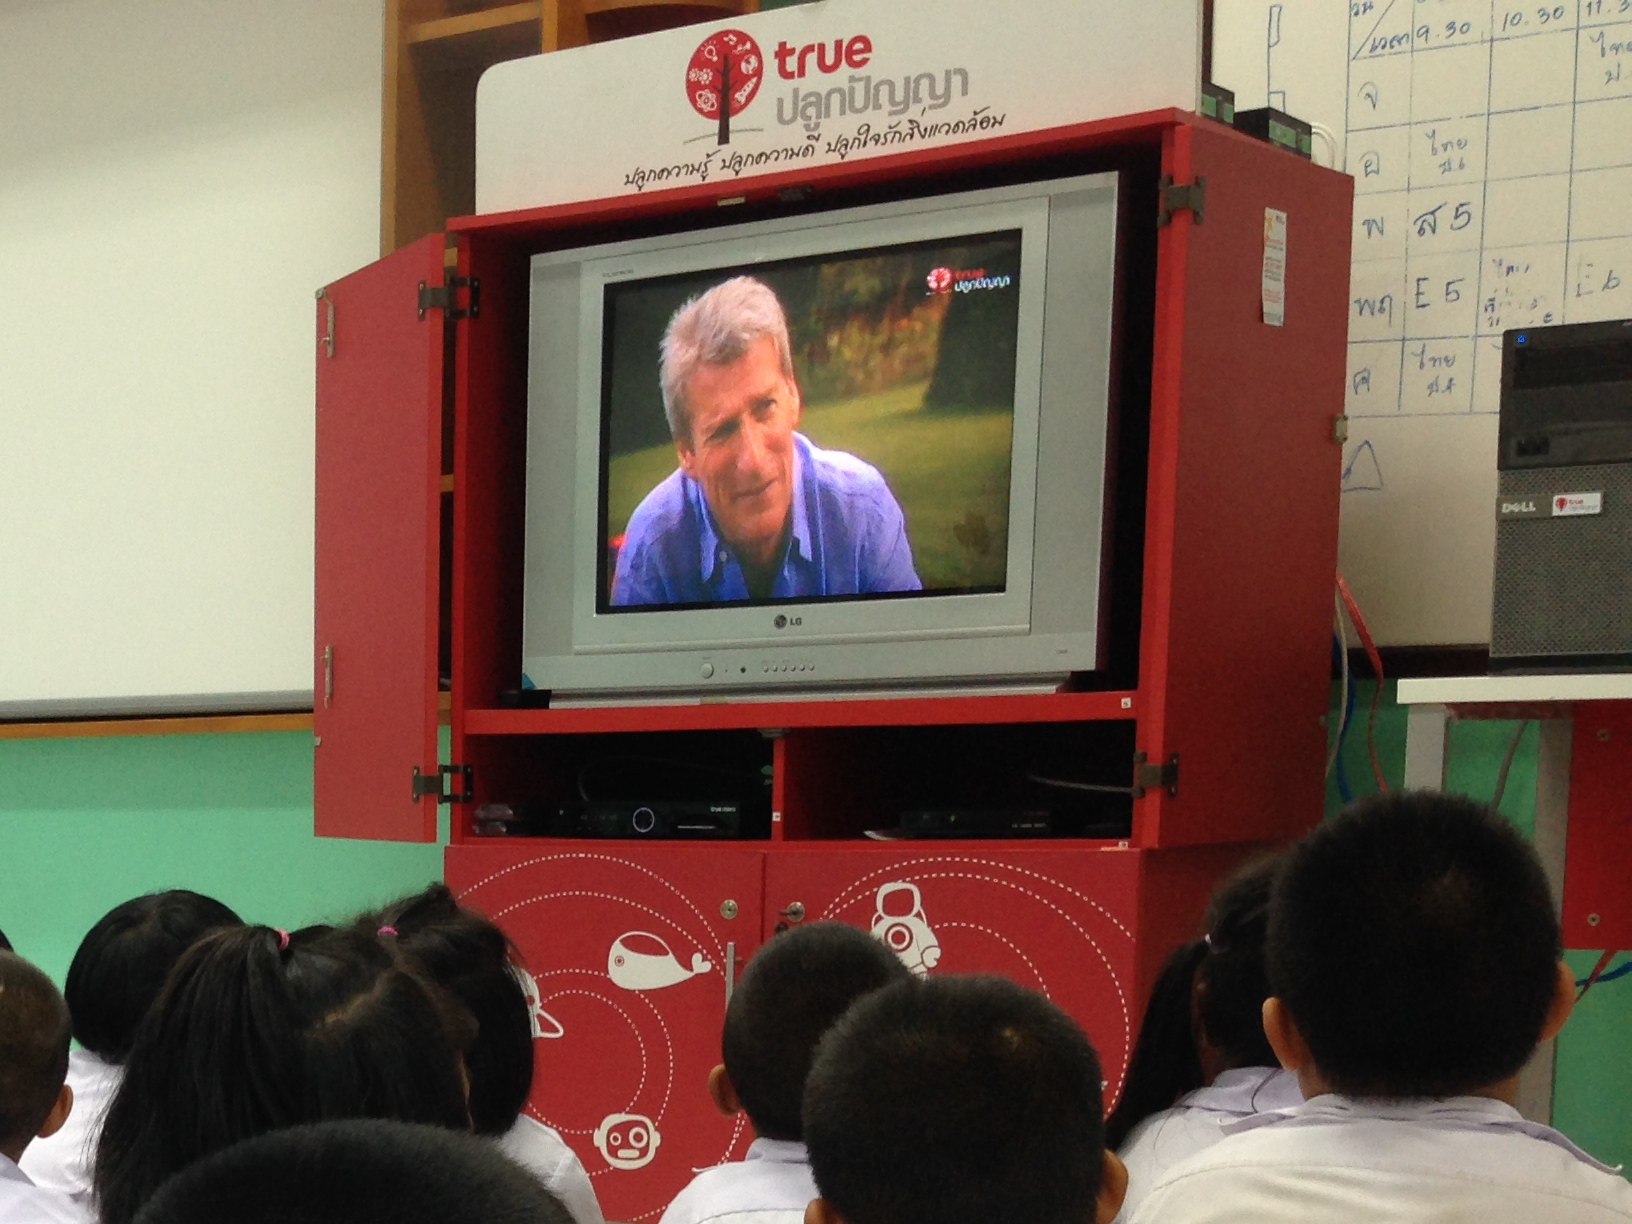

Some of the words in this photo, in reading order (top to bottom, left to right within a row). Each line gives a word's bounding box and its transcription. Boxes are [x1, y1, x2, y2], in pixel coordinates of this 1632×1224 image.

[774, 34, 873, 80] true
[776, 67, 970, 134] ปลูกปัญญา
[623, 149, 724, 193] ปลูกความรู้
[721, 134, 822, 179] ปลูกความดี
[826, 106, 1008, 161] ปลูกใจรักสิ่งแวดล้อม
[1449, 201, 1472, 232] 5
[1415, 277, 1430, 309] E
[1445, 277, 1466, 303] 5
[1501, 501, 1537, 514] DELL
[790, 617, 802, 626] LG
